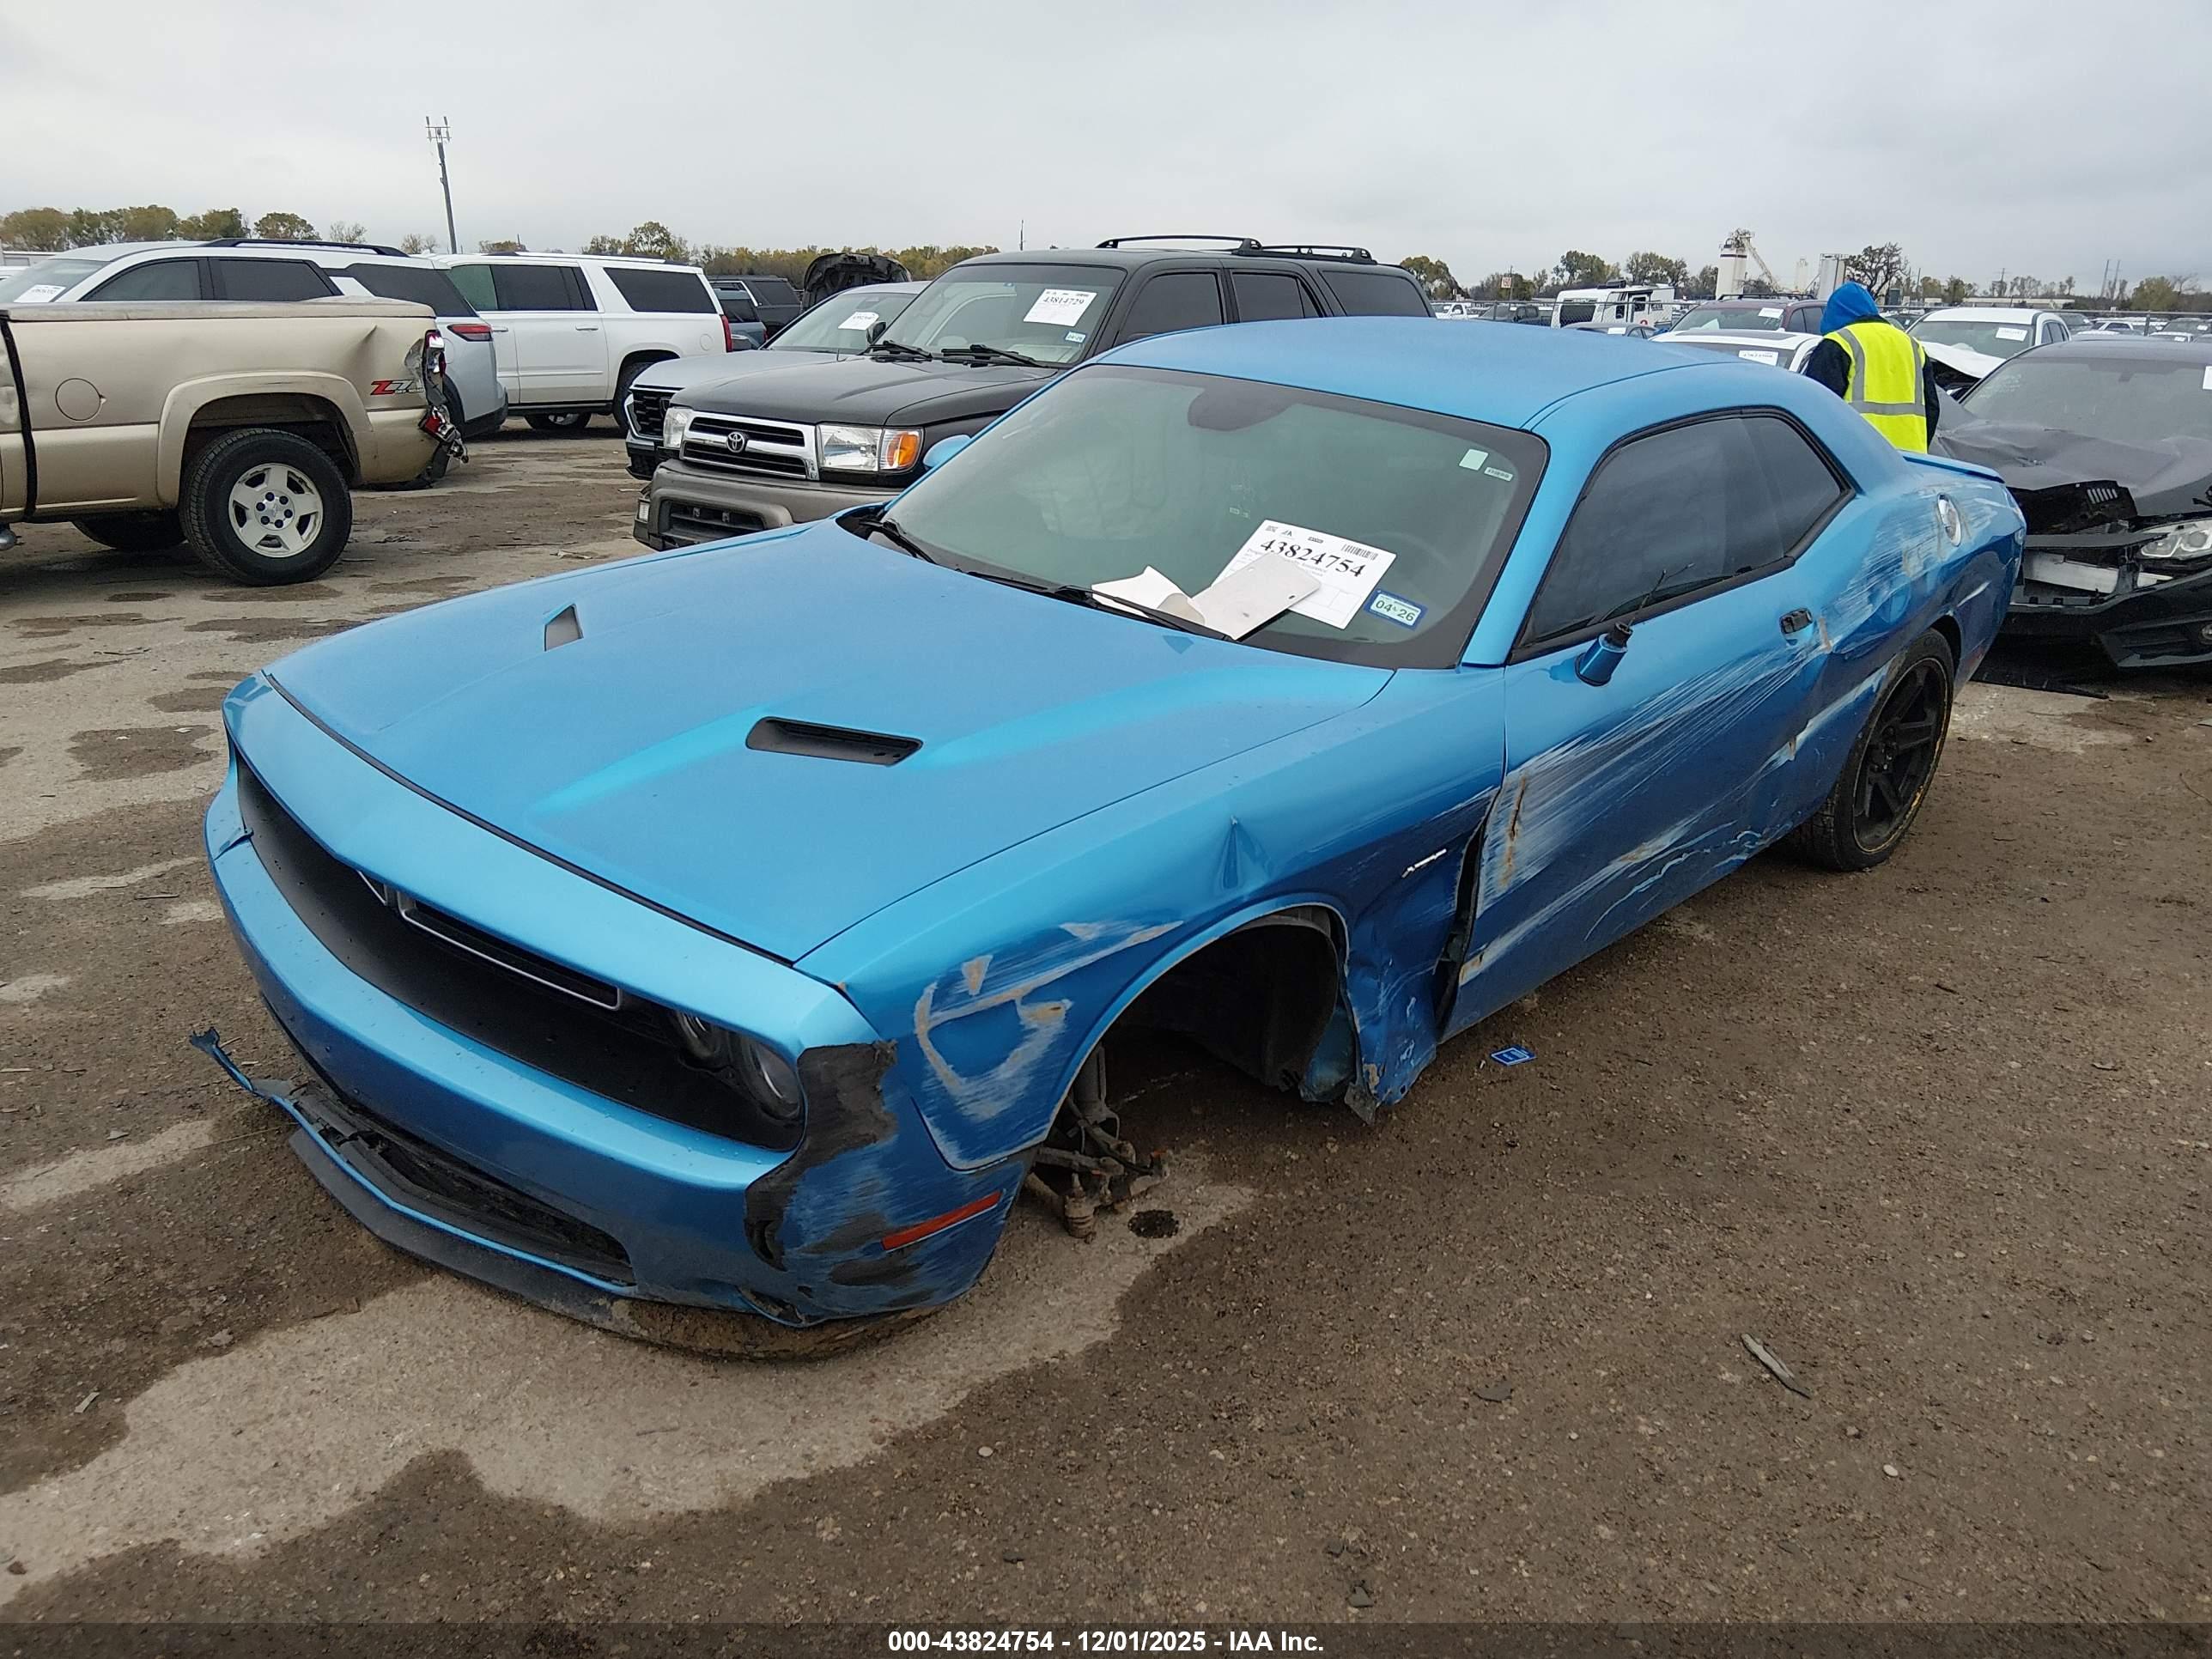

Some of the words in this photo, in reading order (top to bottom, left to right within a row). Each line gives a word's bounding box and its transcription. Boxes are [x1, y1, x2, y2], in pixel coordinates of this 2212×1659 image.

[1260, 539, 1366, 577] 43824754
[1376, 599, 1393, 612] 04
[1397, 608, 1416, 622] 26
